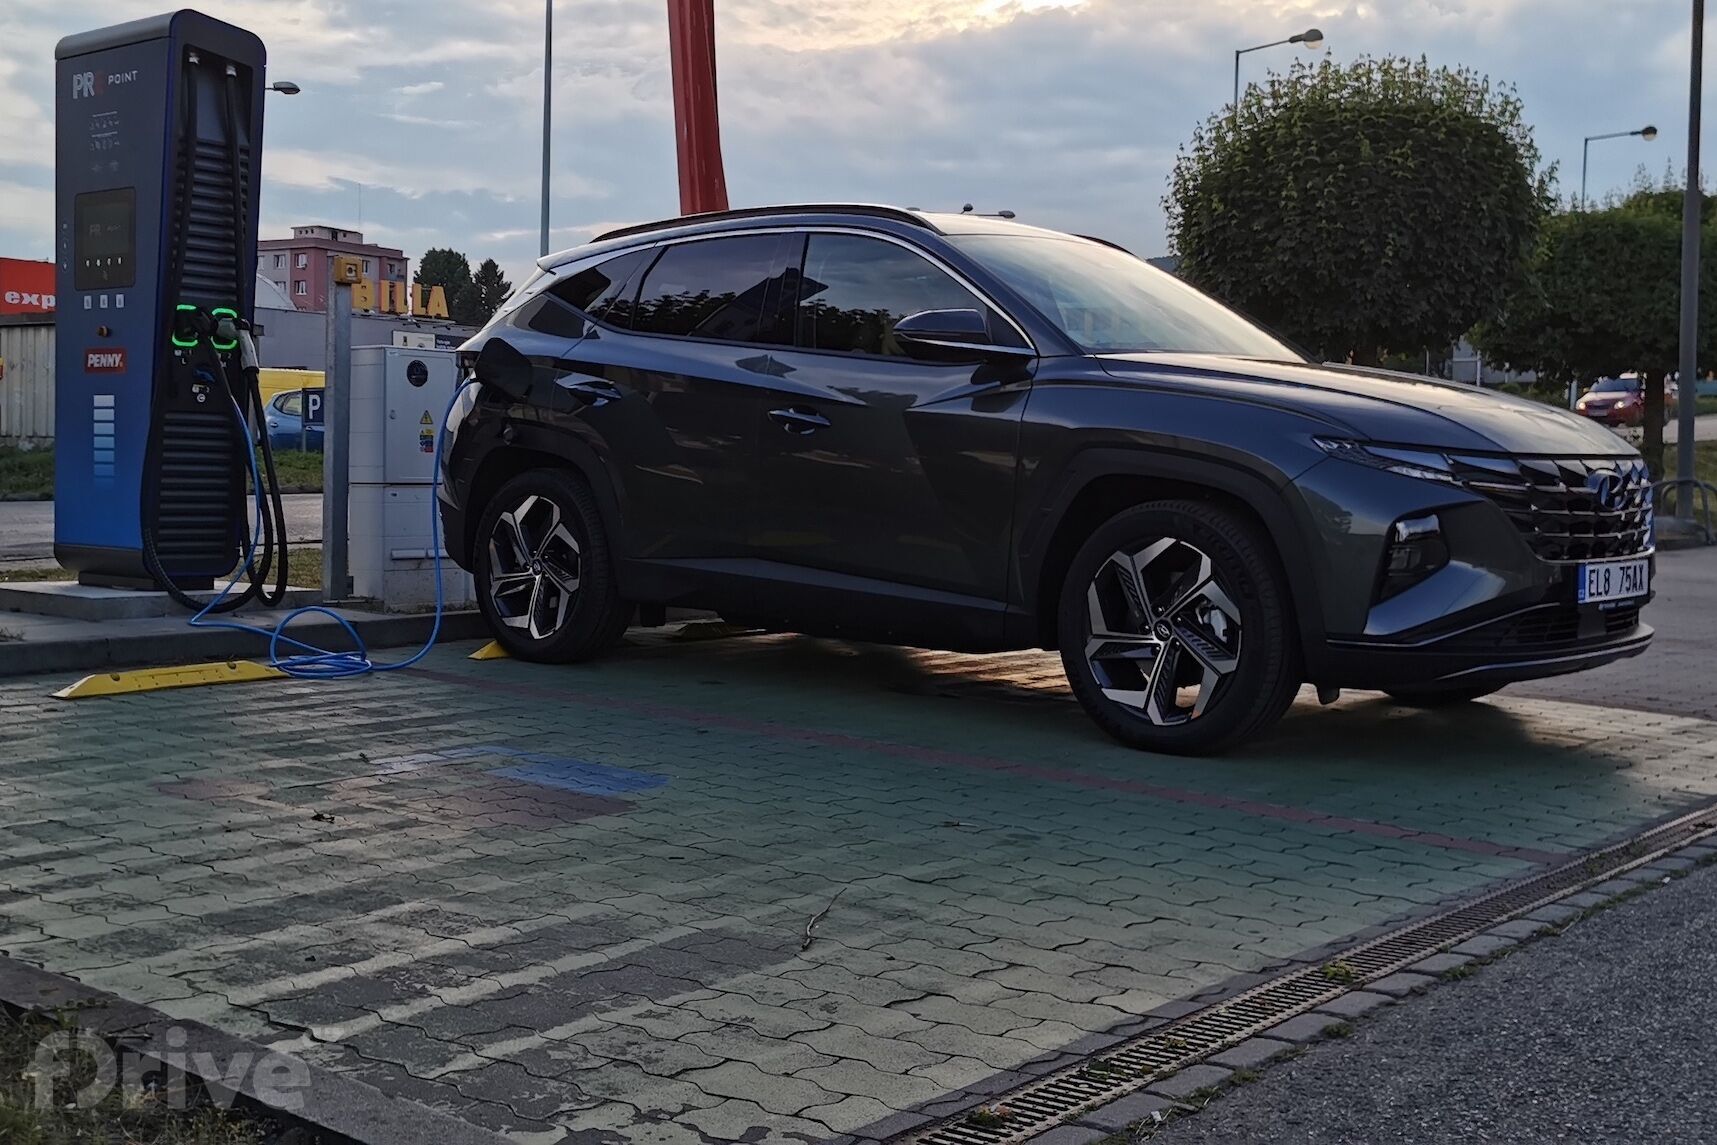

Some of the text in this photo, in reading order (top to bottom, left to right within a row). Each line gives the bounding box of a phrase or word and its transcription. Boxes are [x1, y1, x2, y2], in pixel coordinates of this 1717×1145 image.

[108, 70, 138, 85] POINT
[351, 279, 450, 318] BILLA
[308, 394, 321, 419] P
[1588, 564, 1644, 597] EL8 75AX
